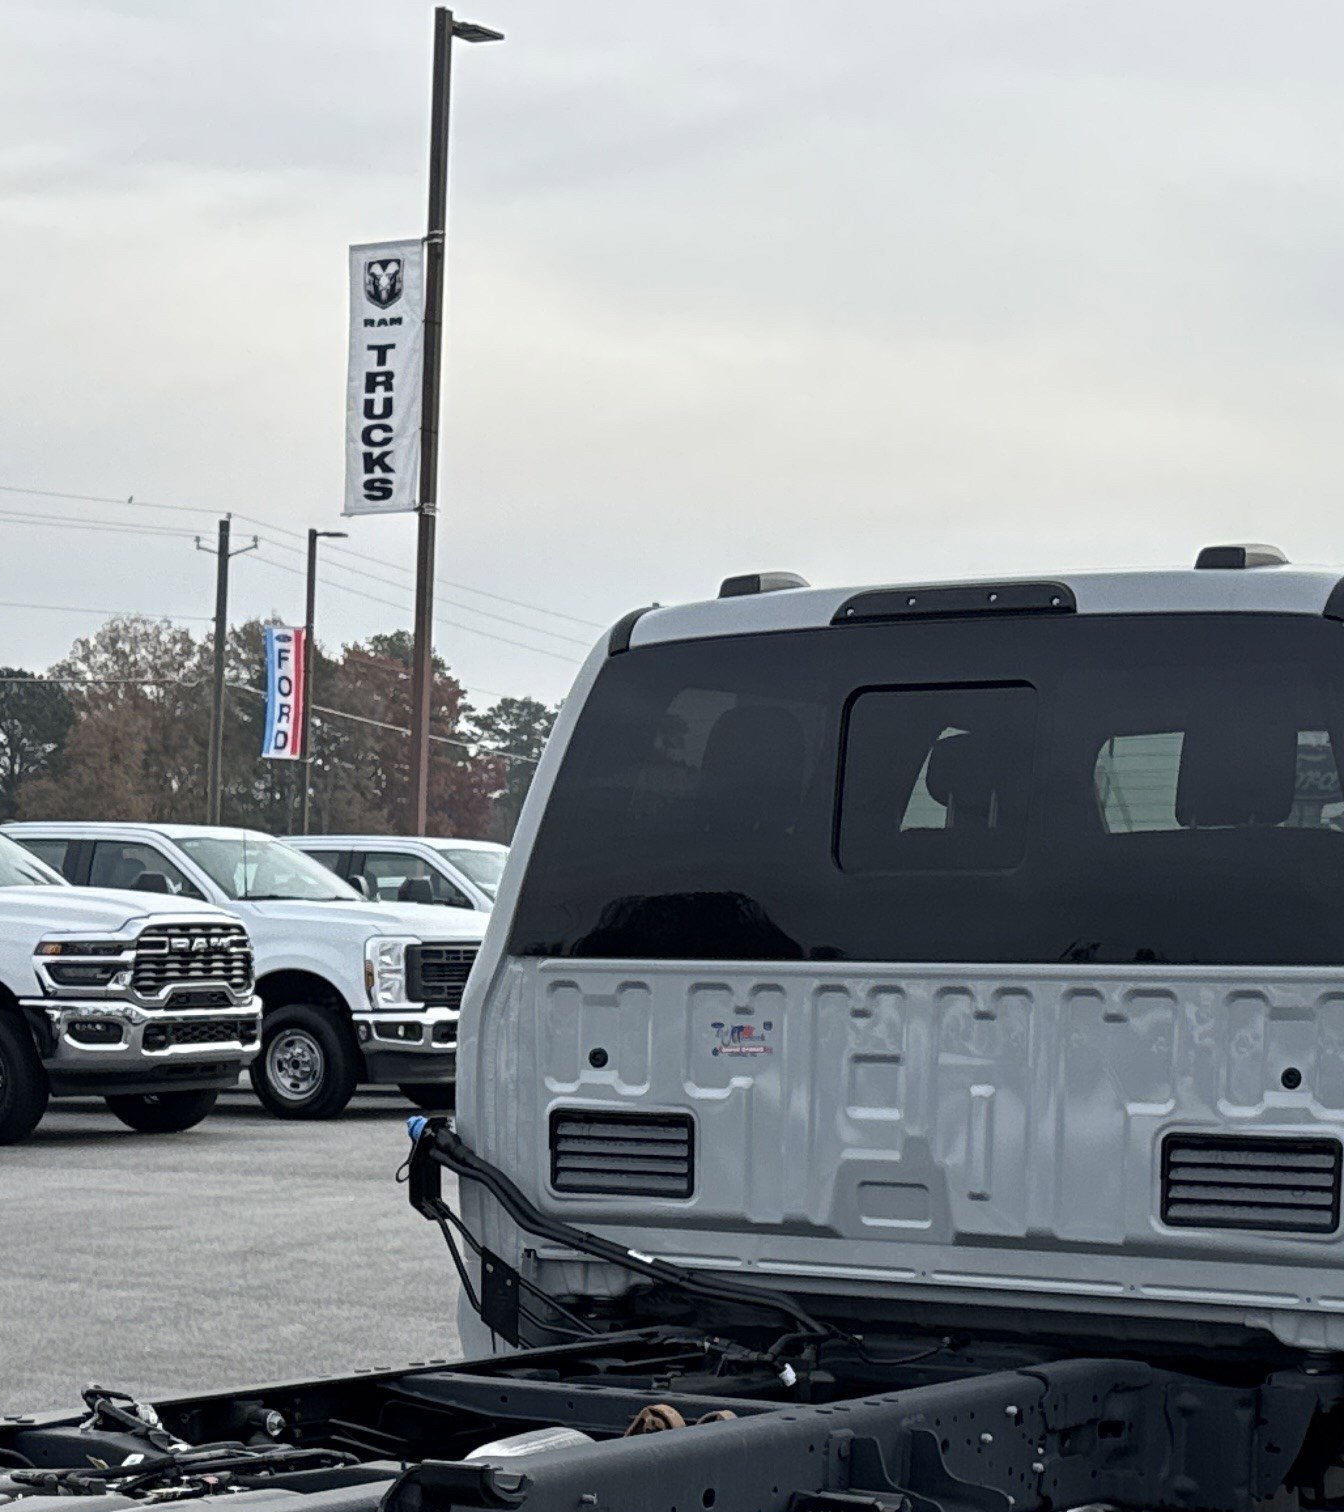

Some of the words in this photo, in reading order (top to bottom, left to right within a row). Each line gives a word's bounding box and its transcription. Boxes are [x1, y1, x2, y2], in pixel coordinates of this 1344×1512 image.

[363, 316, 403, 328] RAM
[361, 343, 396, 501] TRUCKS
[273, 648, 293, 750] FORD
[171, 937, 230, 953] RAM
